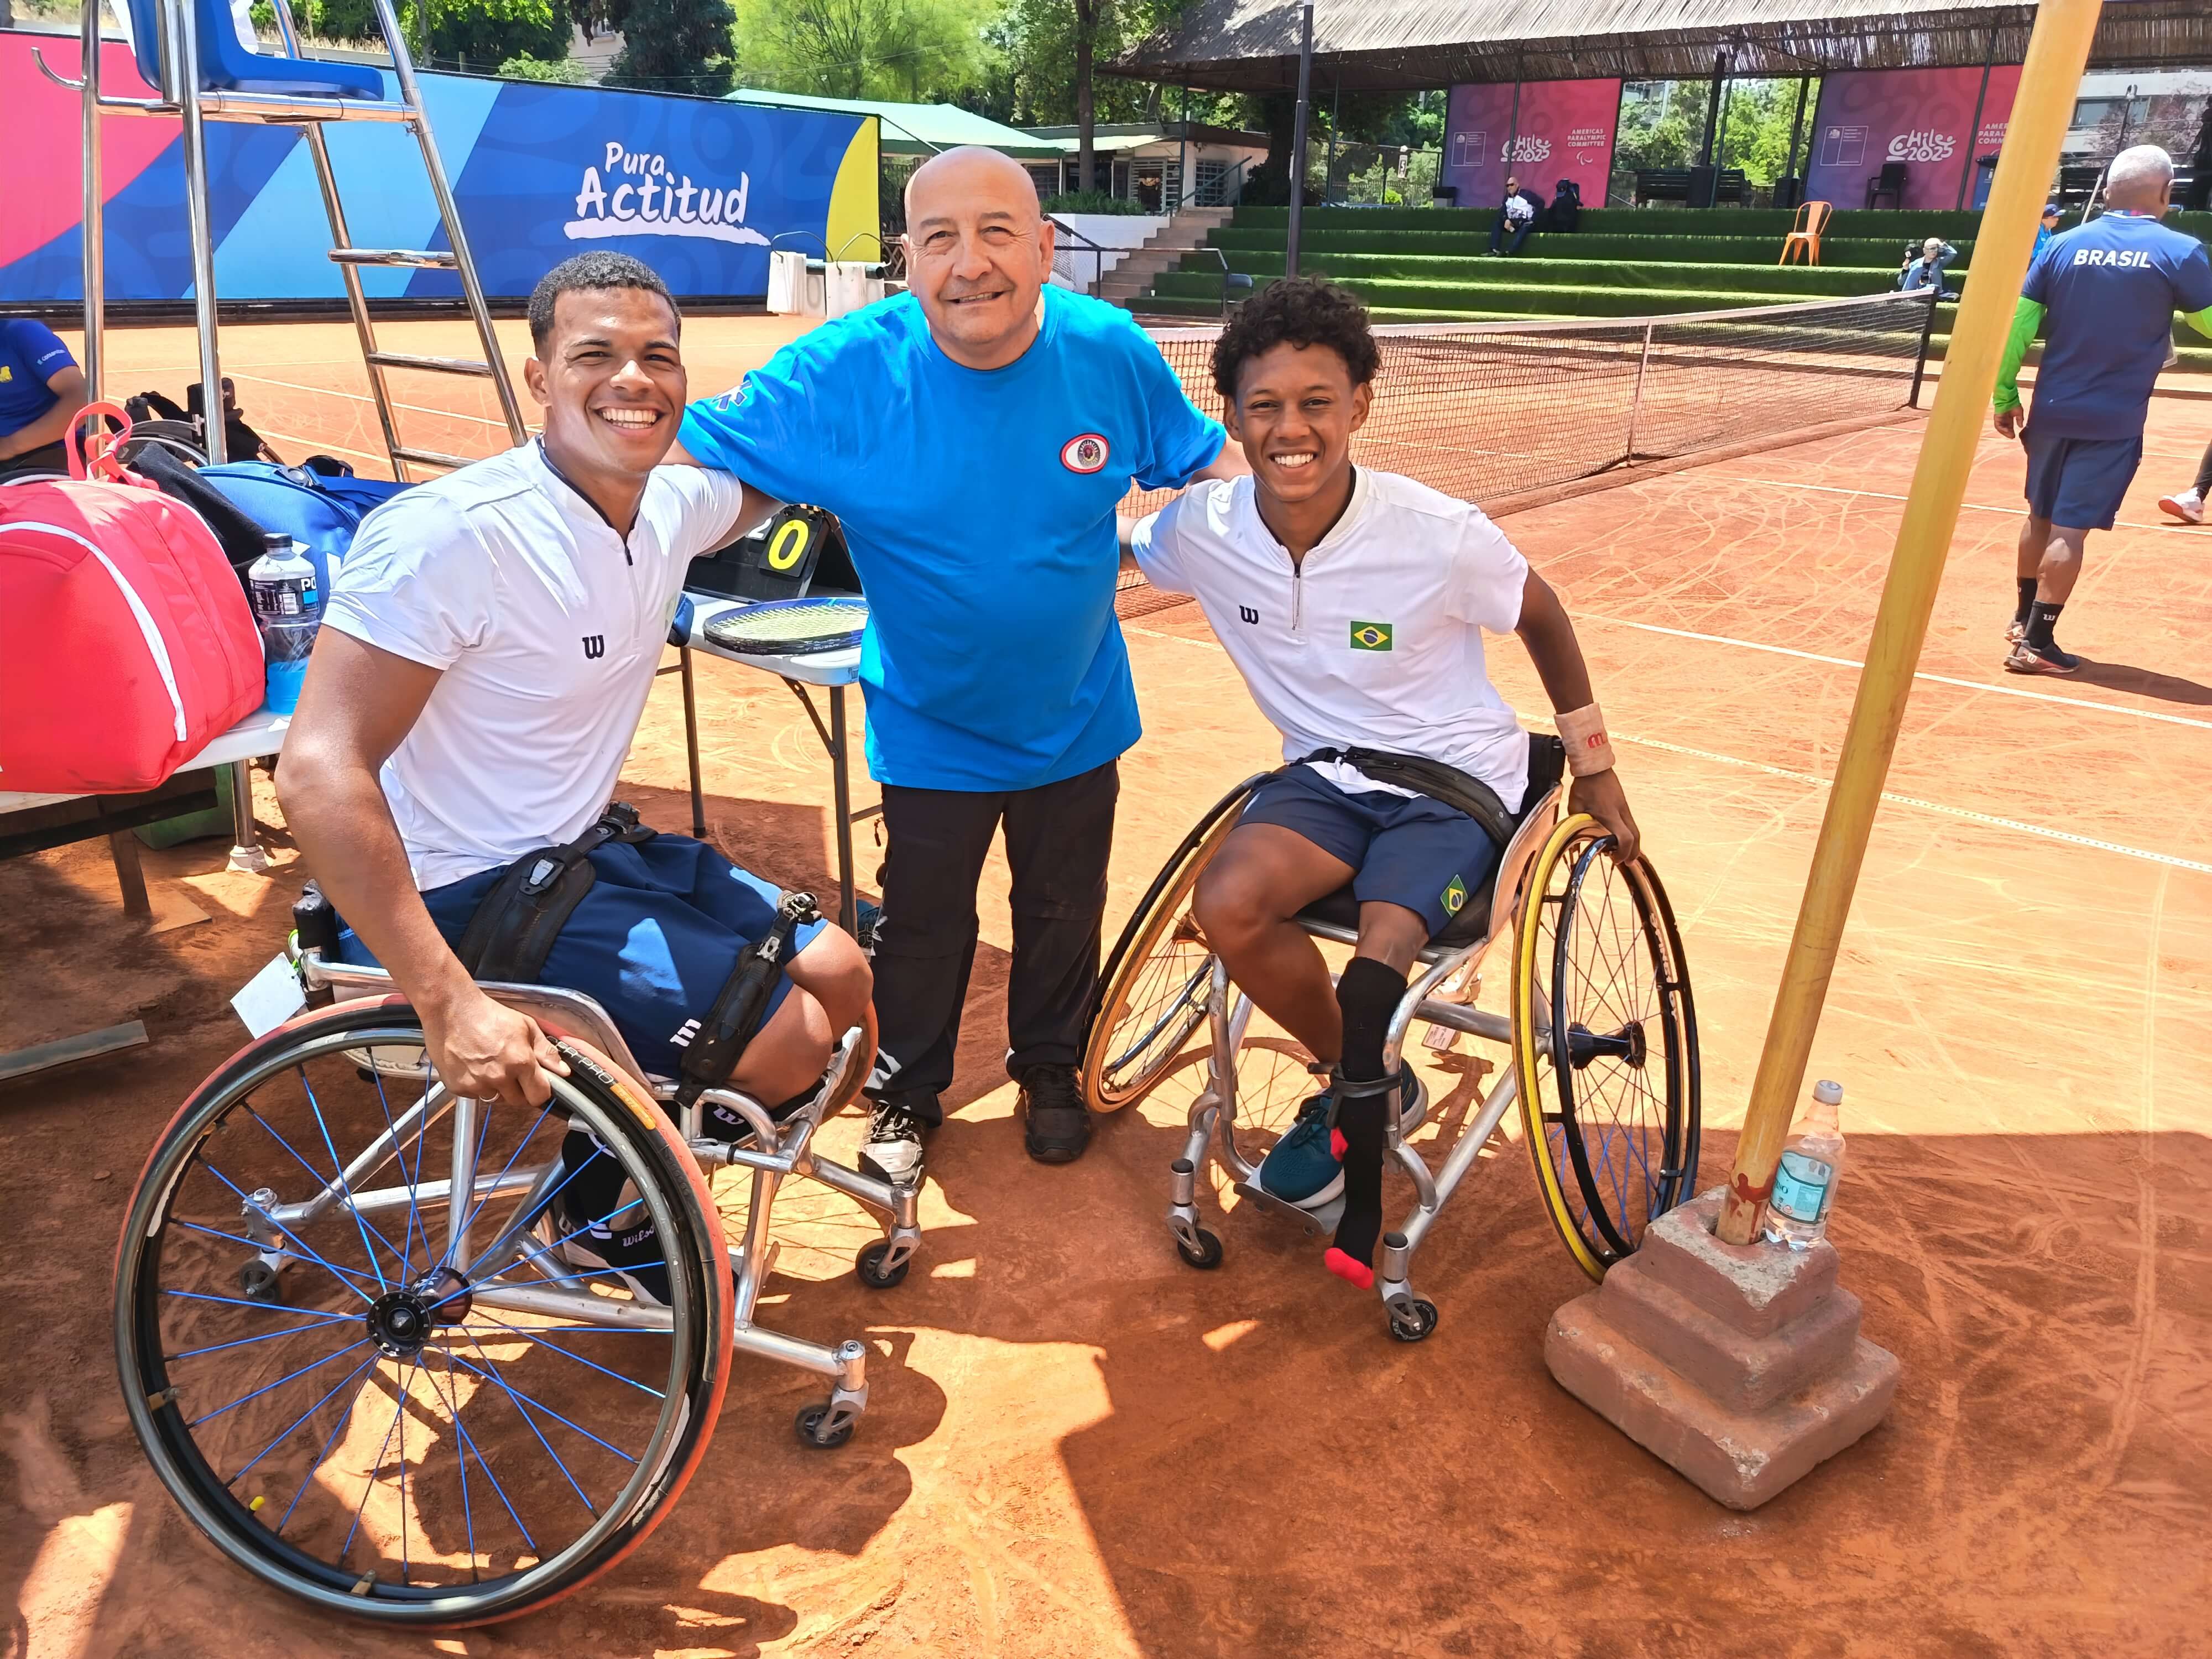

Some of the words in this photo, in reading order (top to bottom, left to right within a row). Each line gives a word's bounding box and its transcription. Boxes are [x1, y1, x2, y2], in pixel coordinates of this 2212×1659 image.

[604, 142, 665, 176] Pura
[1516, 148, 1550, 162] 2025
[1907, 146, 1953, 162] 2025
[575, 166, 749, 224] Actitud
[2073, 249, 2151, 268] BRASIL
[768, 519, 808, 570] 0
[622, 1224, 655, 1247] Wilso
